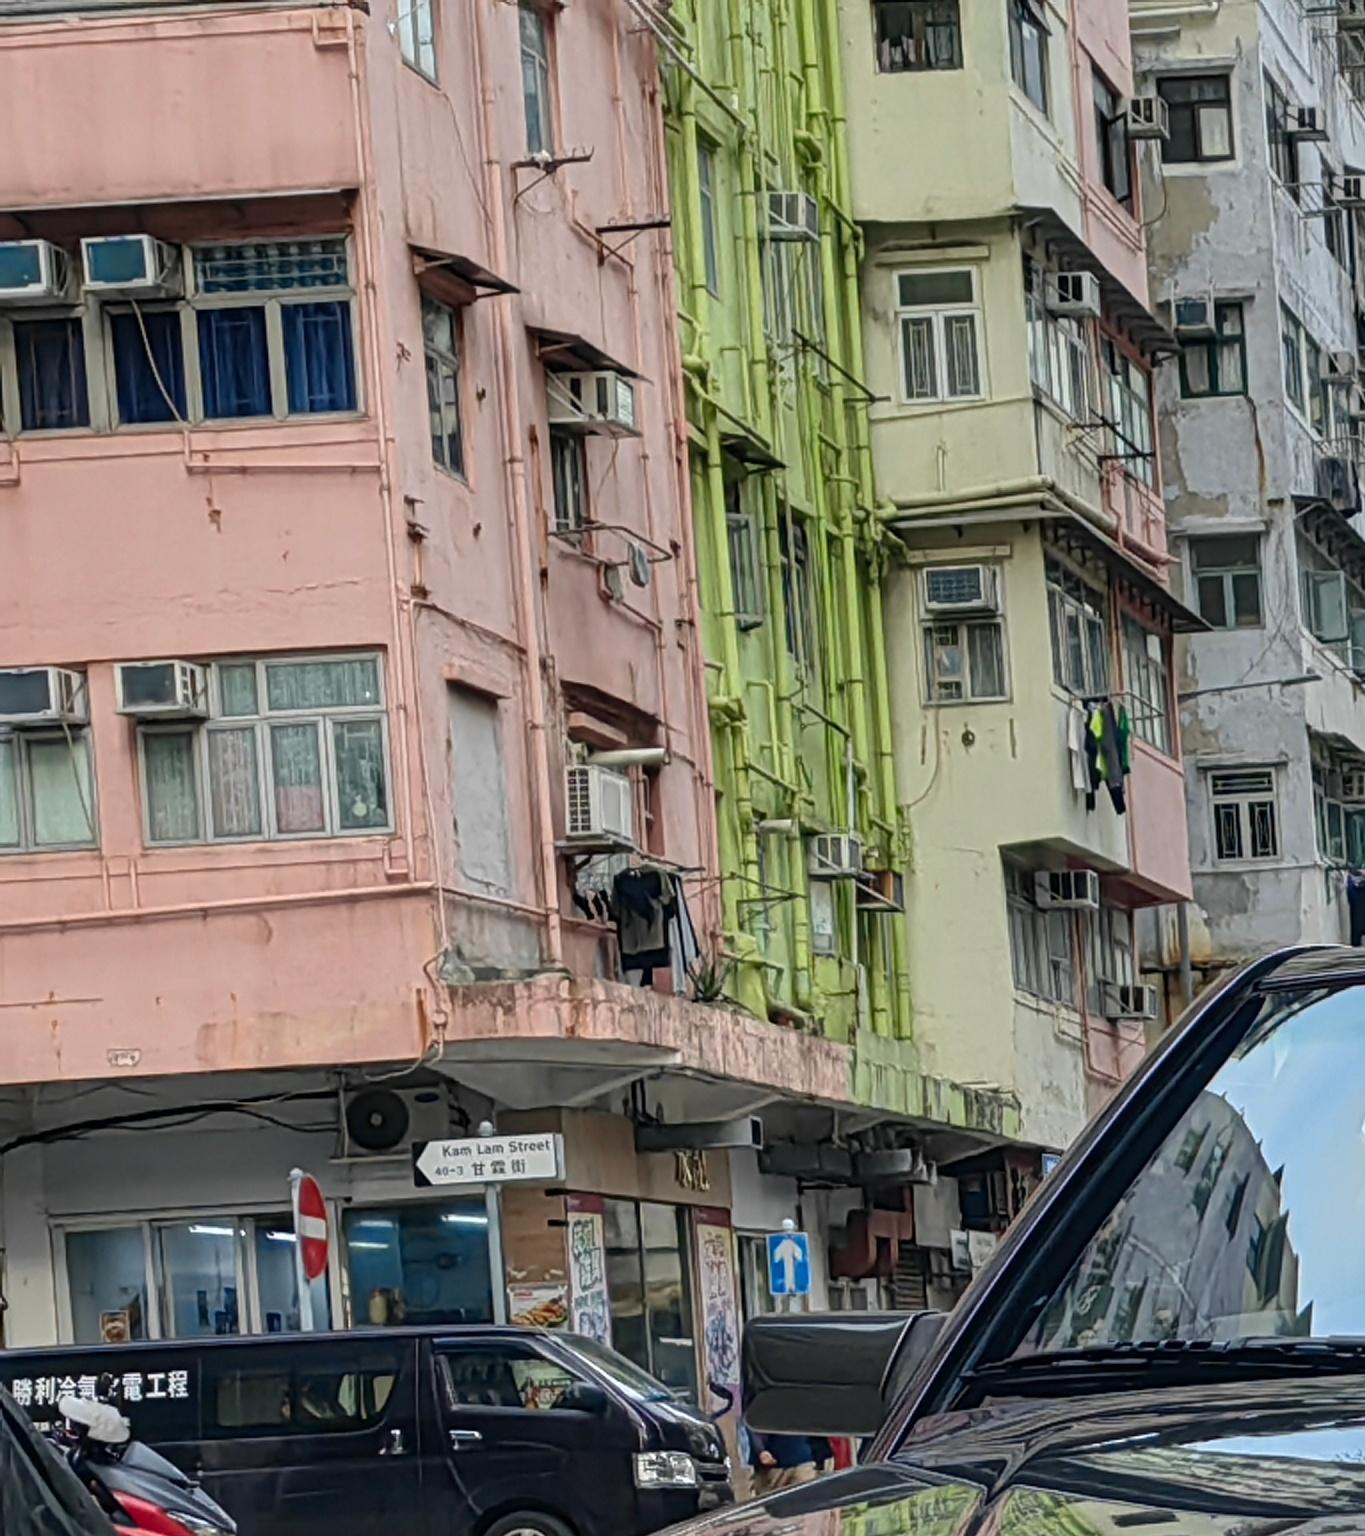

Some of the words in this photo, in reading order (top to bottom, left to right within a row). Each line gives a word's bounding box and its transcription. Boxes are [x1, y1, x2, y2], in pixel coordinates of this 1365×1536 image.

[442, 1144, 472, 1158] Kam
[477, 1142, 504, 1155] Lam
[508, 1139, 550, 1153] Street
